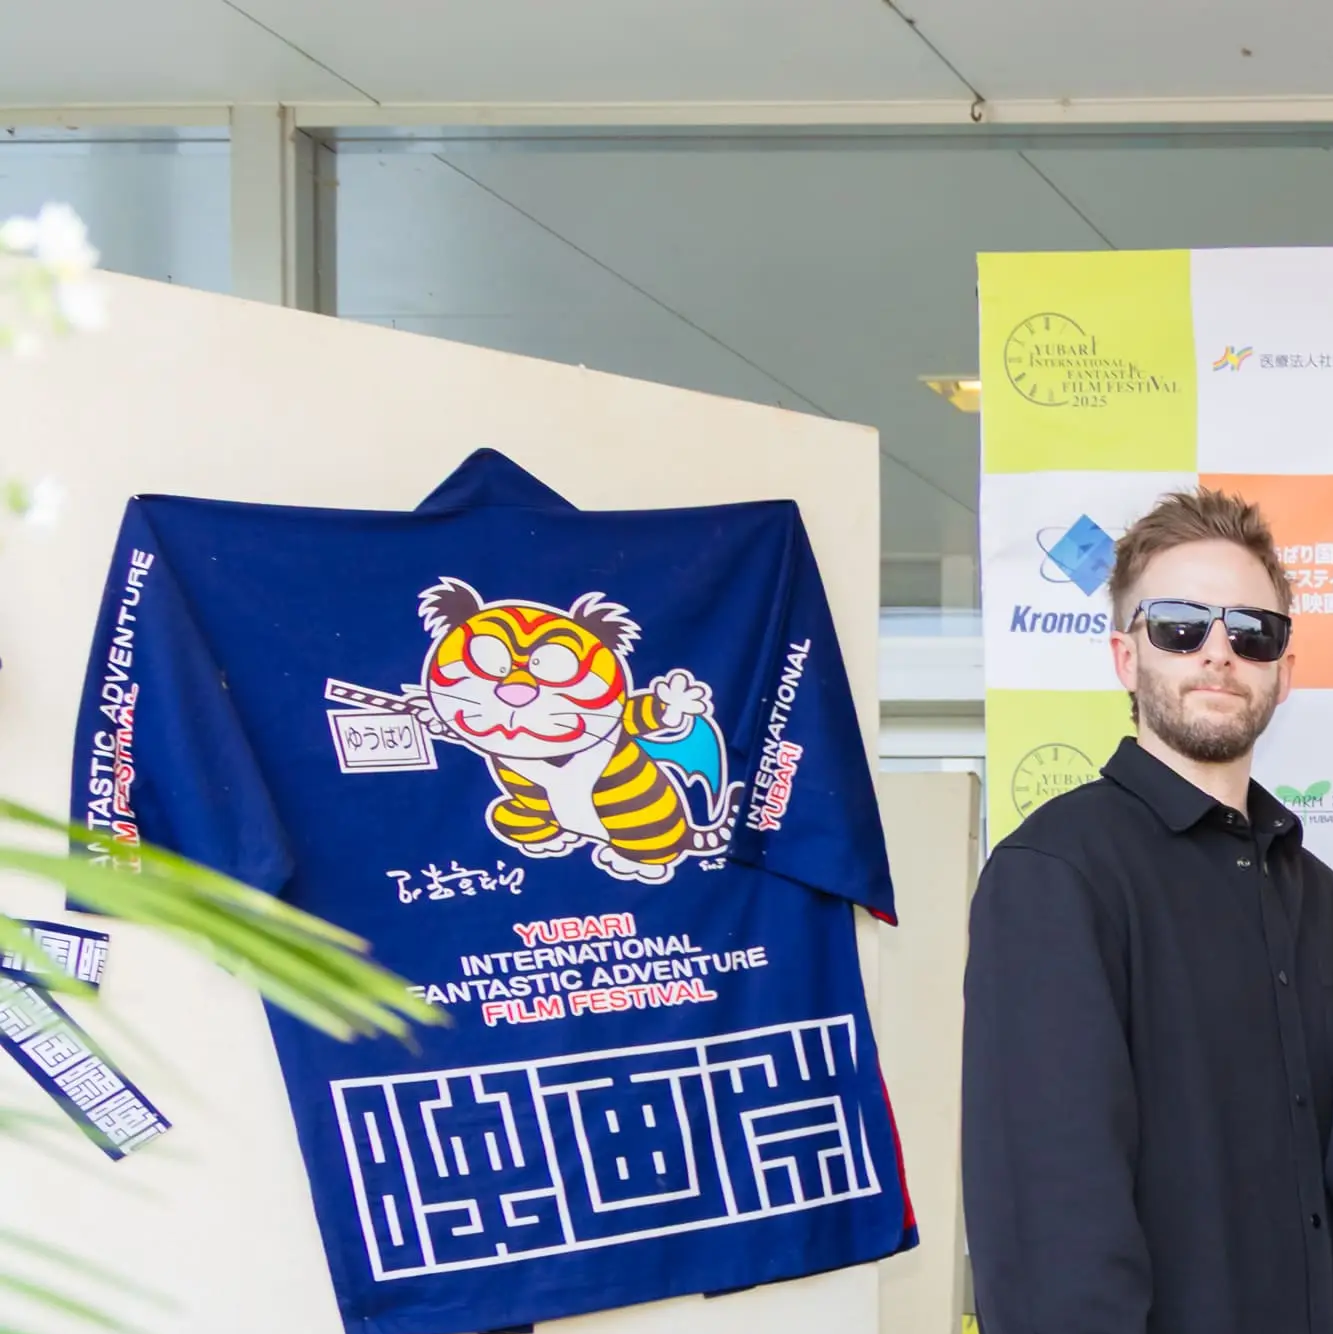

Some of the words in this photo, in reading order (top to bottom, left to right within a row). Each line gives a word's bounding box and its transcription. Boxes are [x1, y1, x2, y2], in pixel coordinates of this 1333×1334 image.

[1030, 353, 1126, 368] INTERNATIONAL
[1034, 335, 1097, 356] YUBARI
[1062, 381, 1102, 393] FILM
[1106, 376, 1180, 393] FESTIVAL
[1072, 395, 1107, 407] 2025
[99, 548, 155, 724] ADVENTURE
[1010, 604, 1109, 635] Kronos
[746, 638, 812, 830] INTERNATIONAL
[759, 740, 804, 831] YUBARI
[513, 912, 636, 948] YUBARI
[460, 933, 702, 977] INTERNATIONAL
[591, 946, 769, 989] ADVENTURE
[482, 994, 566, 1027] FILM
[569, 977, 718, 1016] FESTIVAL
